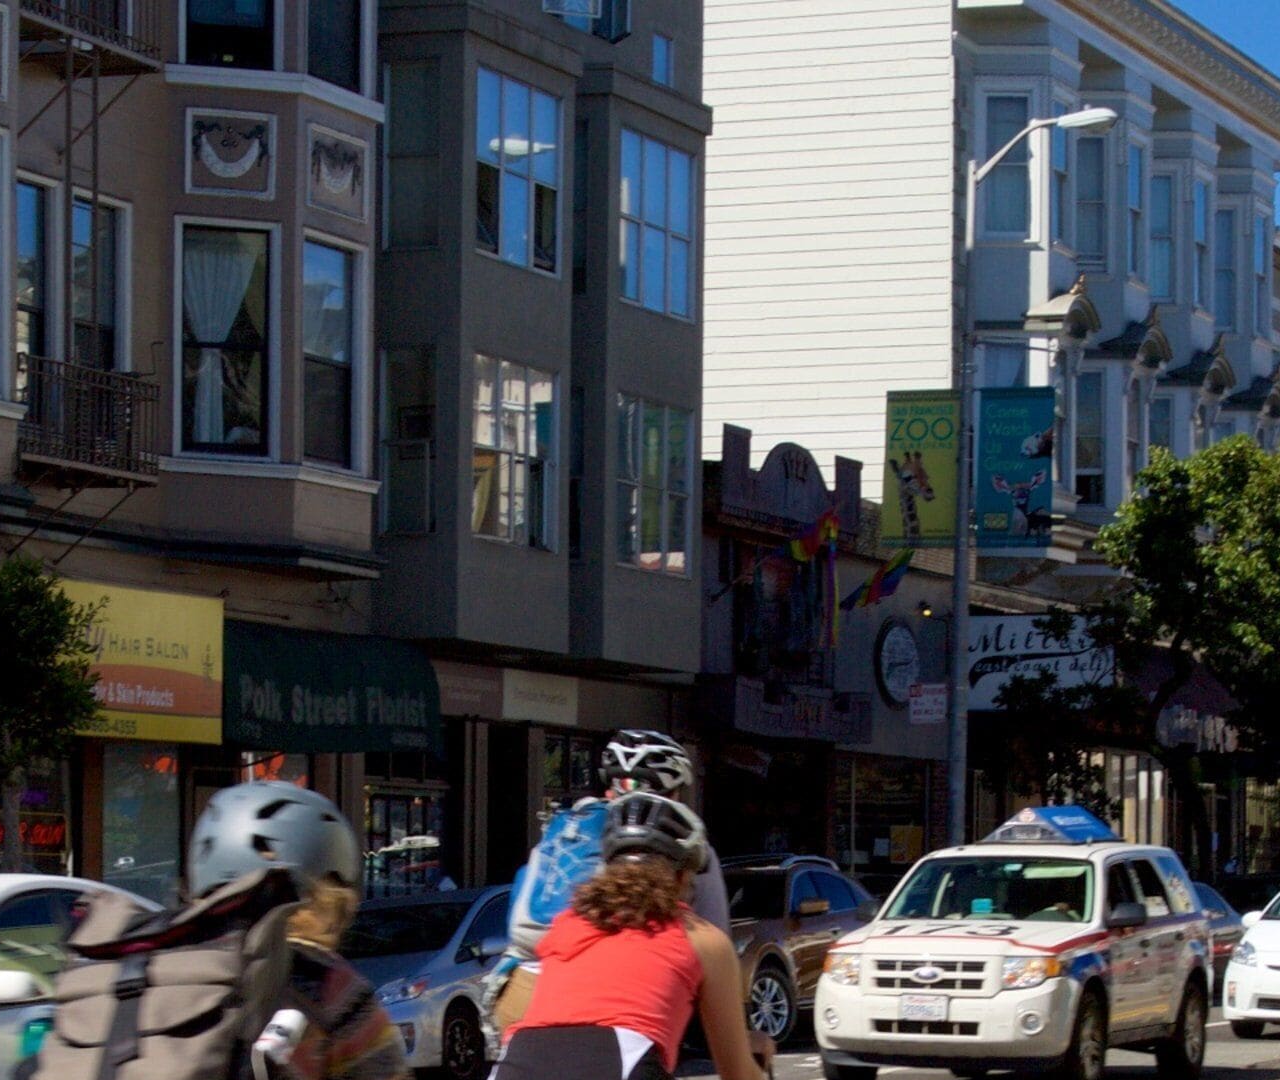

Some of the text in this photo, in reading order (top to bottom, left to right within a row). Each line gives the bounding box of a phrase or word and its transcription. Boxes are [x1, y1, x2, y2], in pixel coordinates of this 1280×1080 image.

[890, 417, 955, 442] ZOO
[110, 632, 142, 656] HAIR
[146, 637, 190, 660] SALON
[291, 684, 360, 726] Street
[882, 923, 1021, 938] 173
